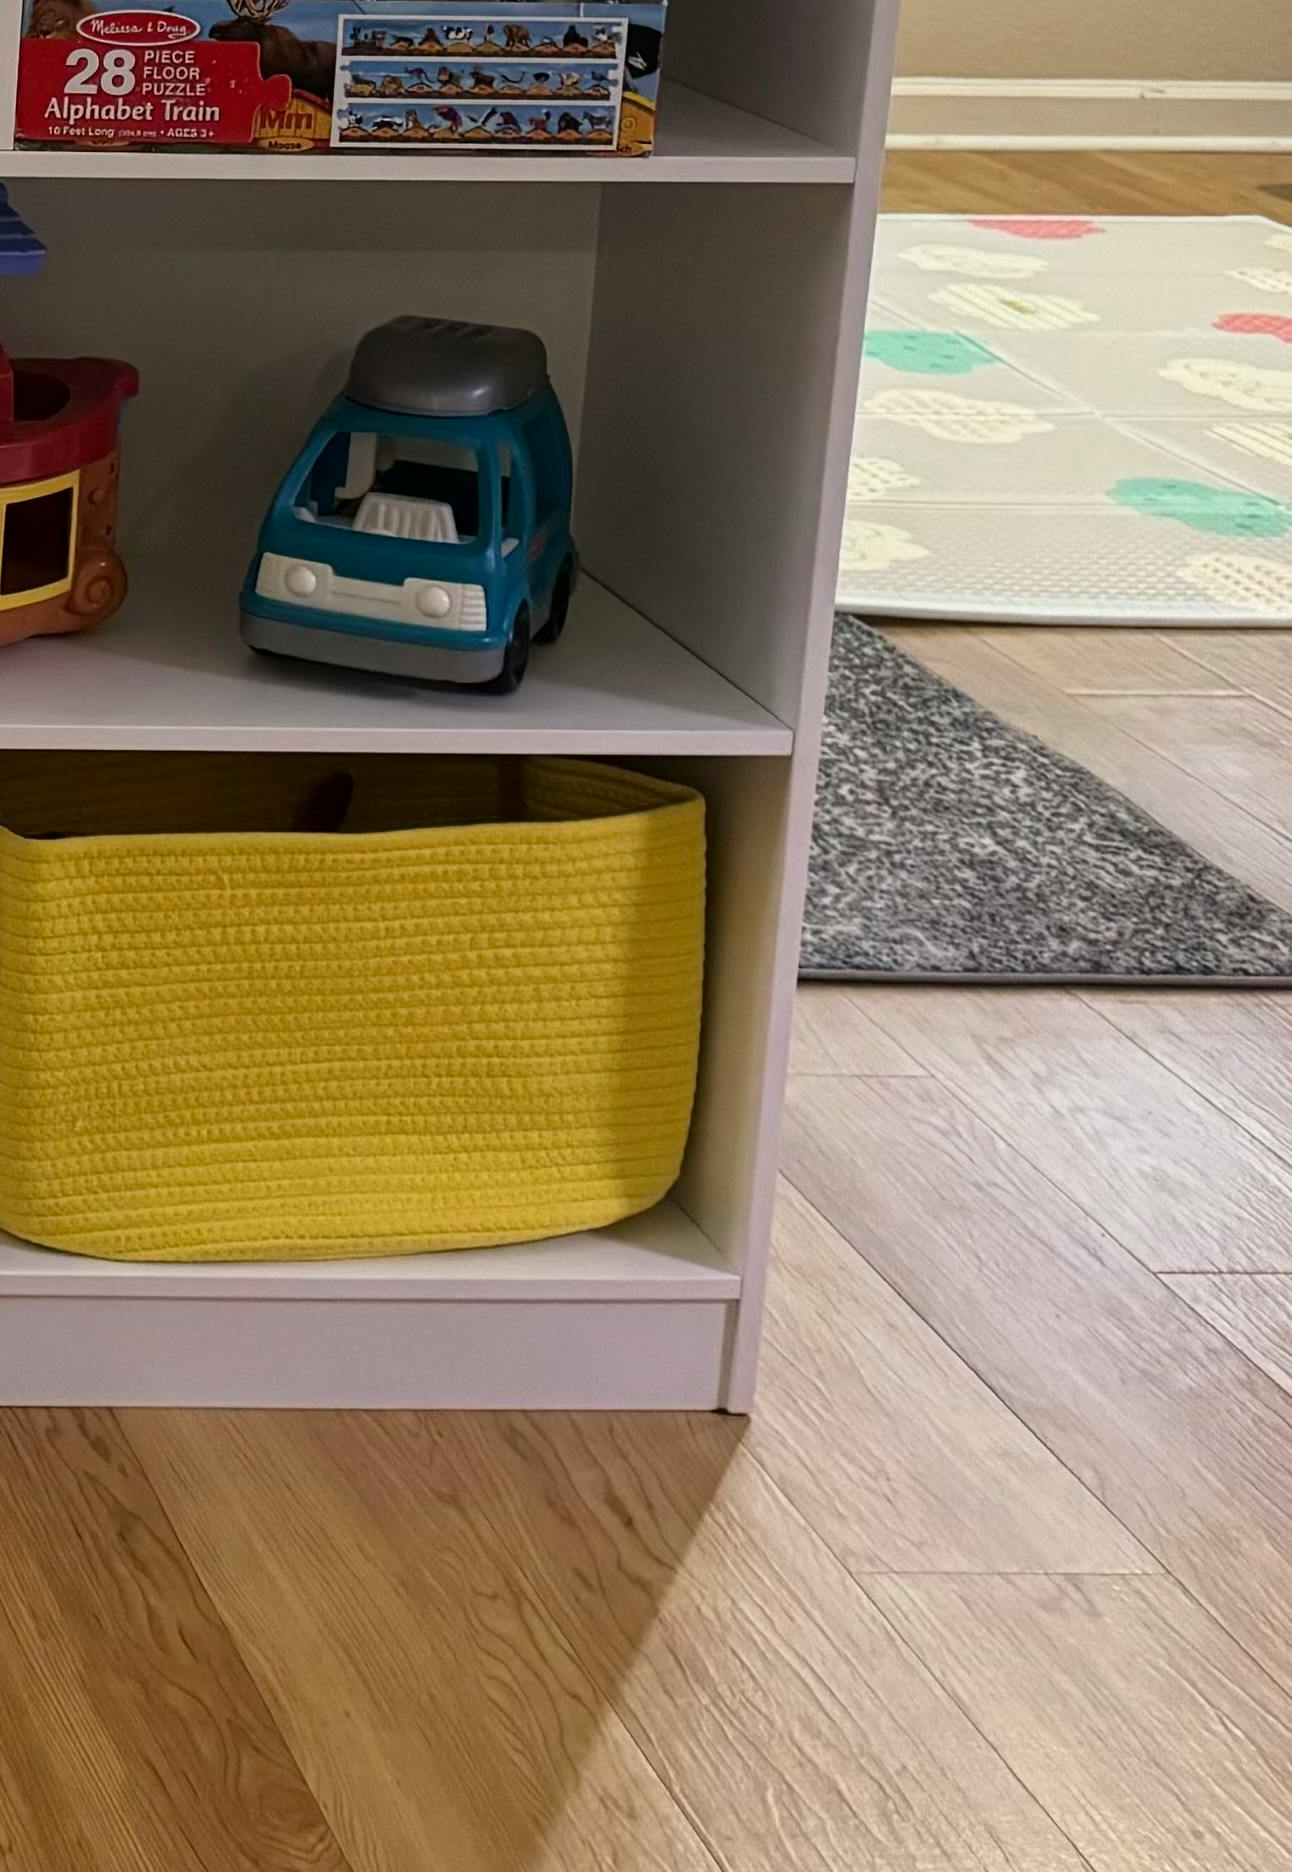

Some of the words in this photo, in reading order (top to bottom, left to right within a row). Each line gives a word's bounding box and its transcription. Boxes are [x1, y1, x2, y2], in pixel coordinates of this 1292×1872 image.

[144, 50, 195, 64] PIECE
[63, 47, 136, 96] 28
[142, 66, 200, 80] FLOOR
[142, 83, 206, 96] PUZZLE
[43, 97, 154, 125] Alphabet
[161, 99, 220, 122] Train
[47, 126, 61, 135] 10
[62, 126, 86, 136] Feet
[88, 127, 114, 138] Long
[166, 128, 198, 138] AGES
